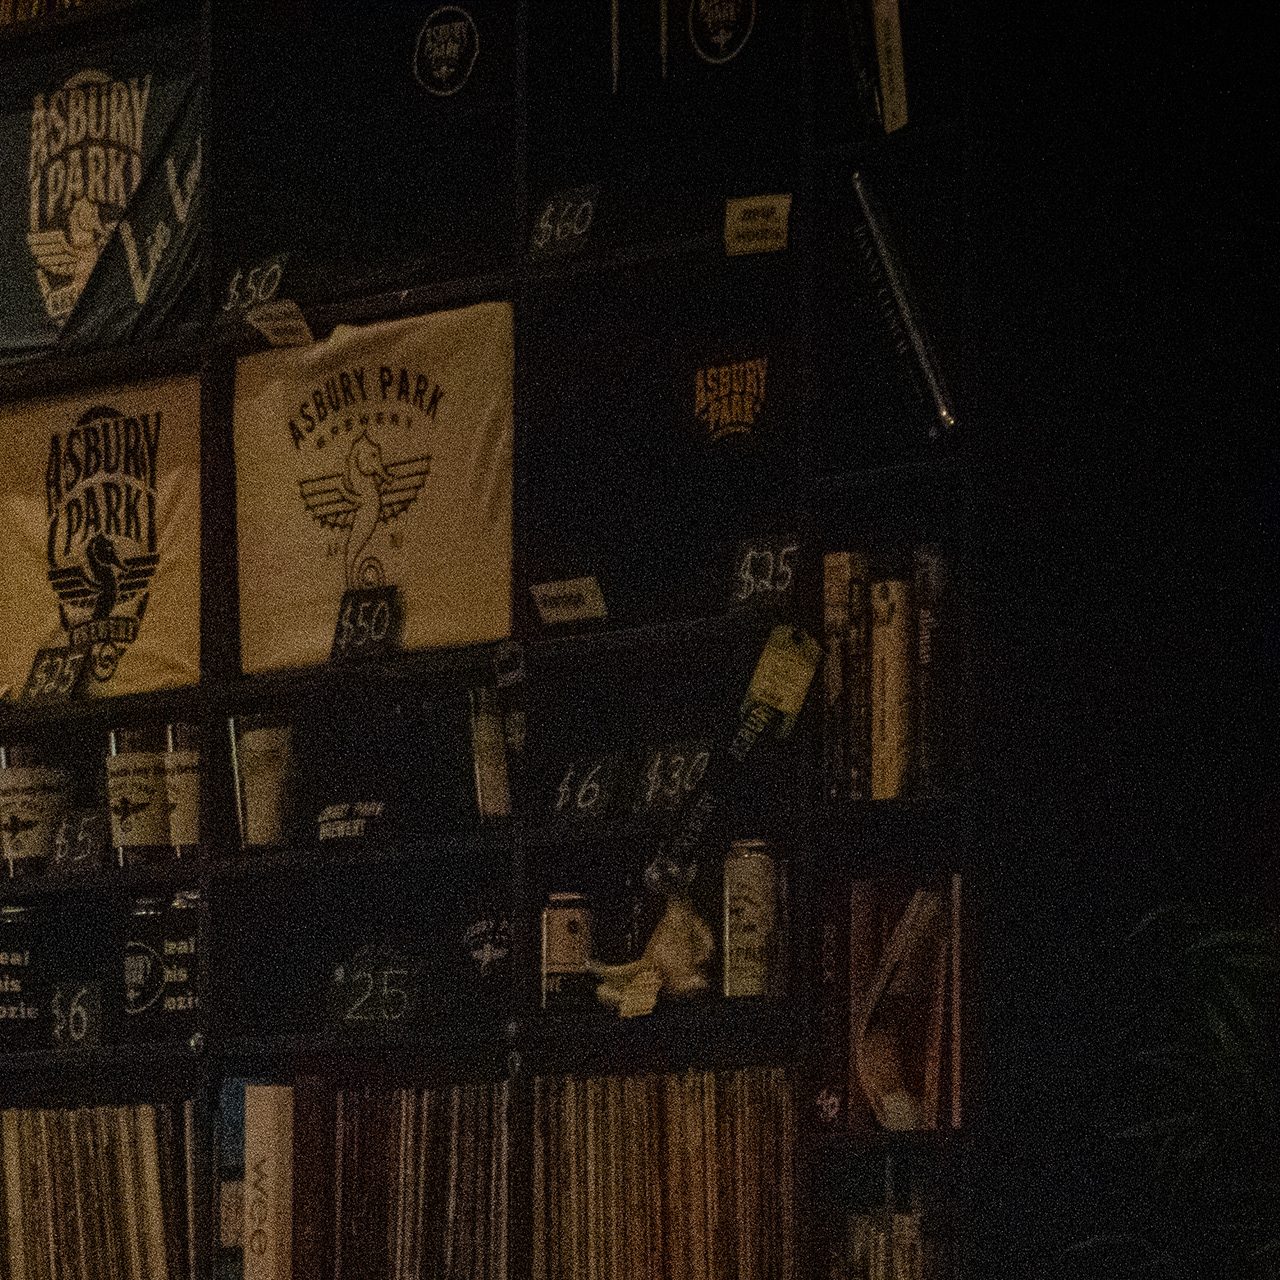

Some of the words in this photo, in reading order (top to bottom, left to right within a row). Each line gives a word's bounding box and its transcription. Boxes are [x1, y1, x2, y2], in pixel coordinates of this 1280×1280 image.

[30, 73, 152, 182] ASBURY
[46, 147, 128, 225] PARK
[290, 367, 368, 450] ASBURY
[378, 366, 445, 420] PARK
[46, 411, 162, 517] ASBURY
[63, 482, 142, 556] PARK
